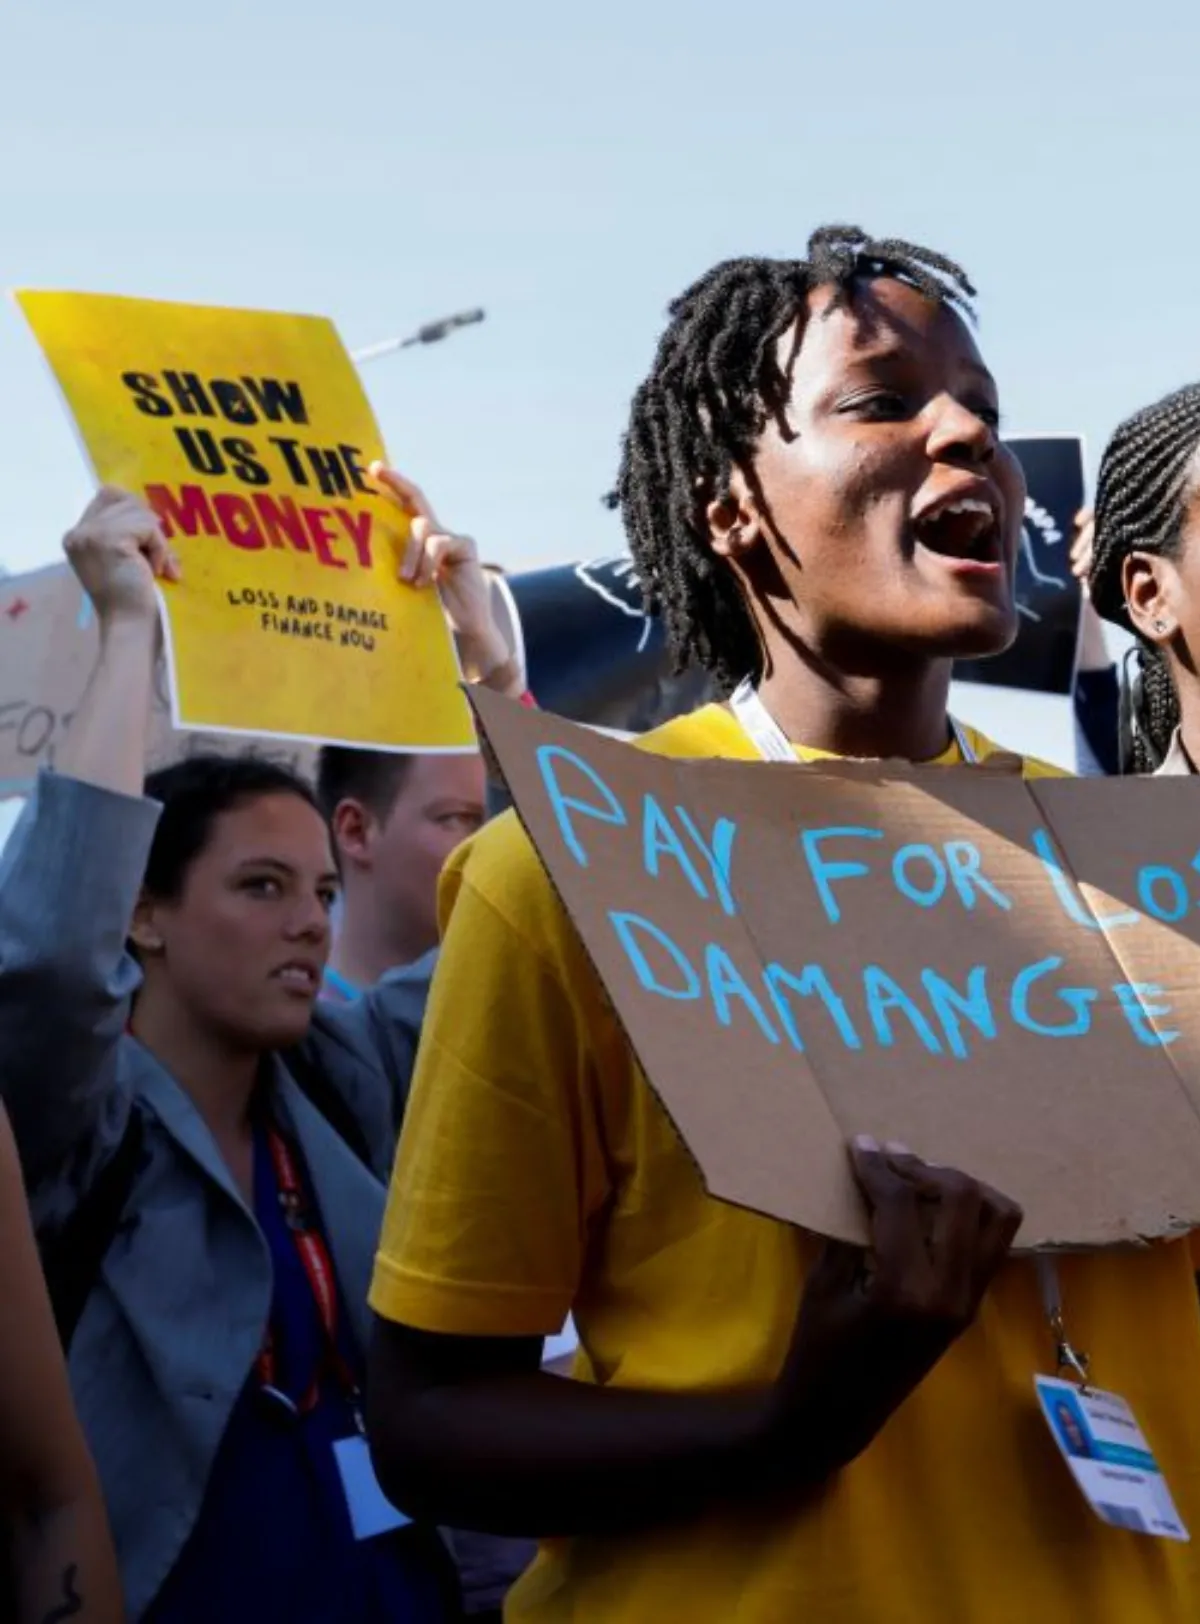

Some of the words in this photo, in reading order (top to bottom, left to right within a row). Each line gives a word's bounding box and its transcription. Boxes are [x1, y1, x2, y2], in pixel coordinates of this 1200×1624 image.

[121, 369, 309, 426] SHOW
[173, 426, 271, 486] US
[268, 435, 379, 499] THE
[144, 483, 373, 570] MONEY
[227, 587, 280, 609] LOSS
[286, 594, 319, 616] AND
[323, 600, 389, 632] DAMAGE
[260, 611, 334, 642] FINANCE
[339, 629, 376, 652] NOW
[535, 744, 737, 917] PAY
[800, 824, 1012, 925] FOR
[607, 909, 1183, 1061] DAMANGE
